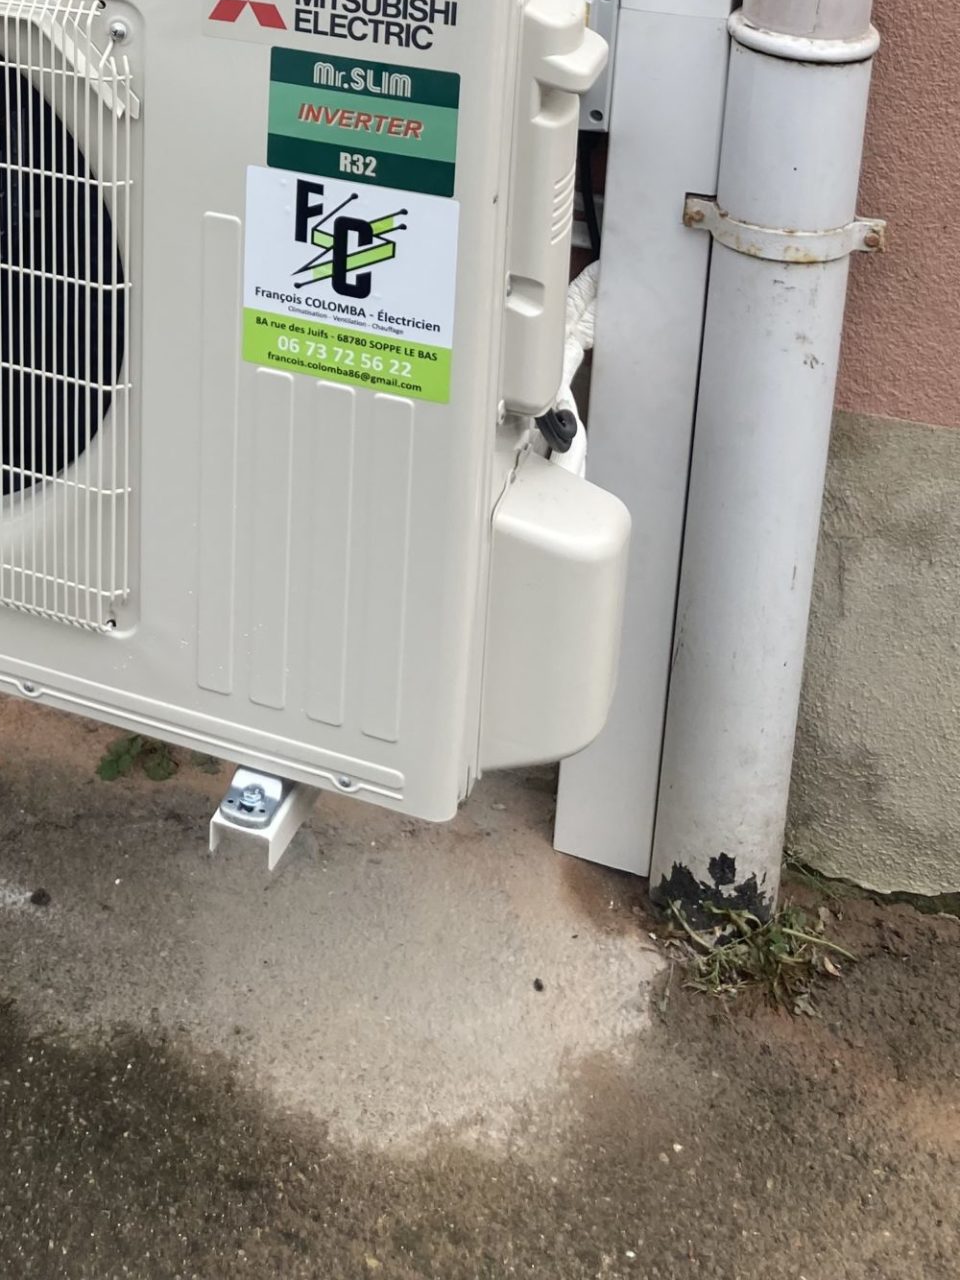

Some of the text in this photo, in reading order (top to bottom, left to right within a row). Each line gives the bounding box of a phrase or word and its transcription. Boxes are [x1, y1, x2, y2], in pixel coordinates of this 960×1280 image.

[294, 8, 434, 50] ELECTRIC
[298, 102, 424, 140] INVERTER
[339, 151, 377, 177] R32
[255, 286, 302, 305] François
[305, 296, 366, 318] COLOMBA
[377, 309, 440, 332] Électricien
[256, 316, 268, 327] 8A
[270, 320, 286, 330] rue
[288, 323, 305, 334] des
[307, 327, 328, 339] Juifs
[337, 333, 367, 347] 68780
[369, 340, 401, 354] SOPPE
[404, 347, 415, 357] LE
[417, 350, 438, 361] BAS
[277, 335, 412, 377] 06 73 72 56 22
[267, 351, 422, 392] francois.colomba86@gmail.com
